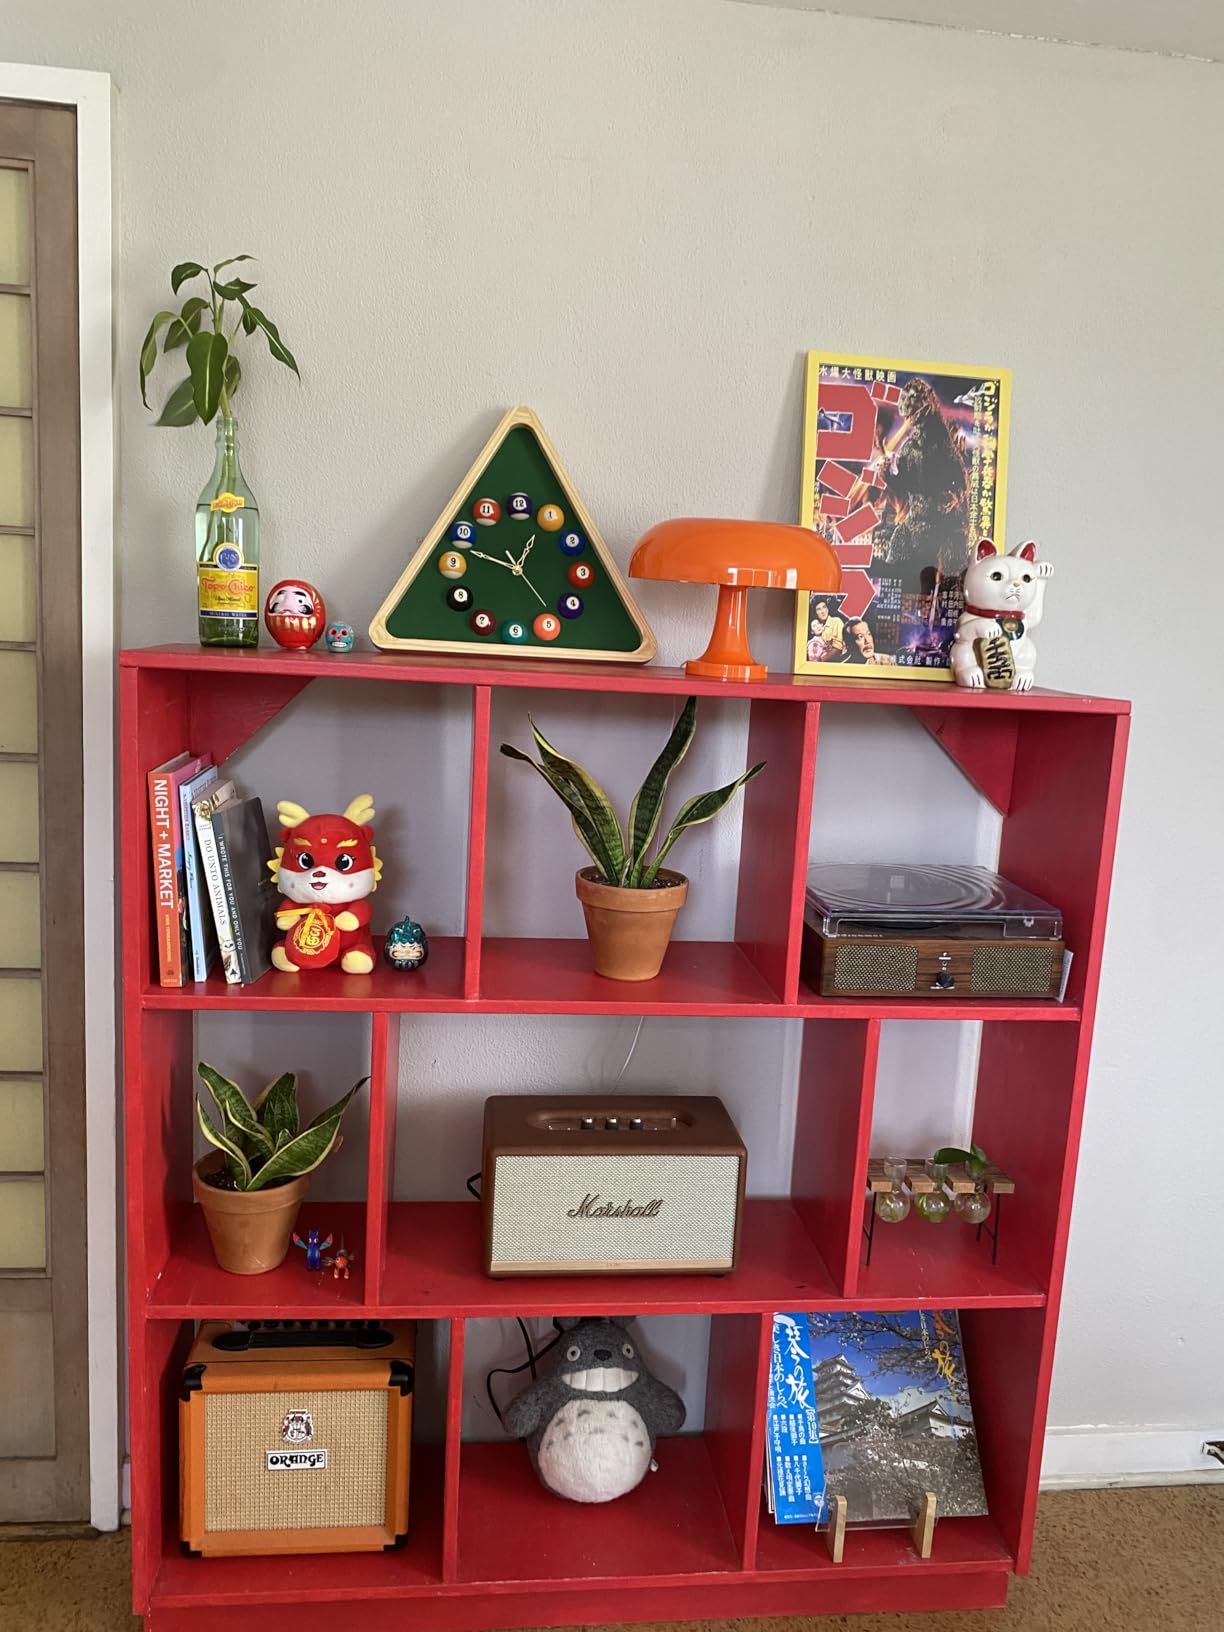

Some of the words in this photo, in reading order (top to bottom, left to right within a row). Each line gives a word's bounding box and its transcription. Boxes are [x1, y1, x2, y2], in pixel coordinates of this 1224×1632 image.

[482, 506, 491, 514] 11
[515, 499, 525, 508] 12
[202, 577, 225, 593] Topo
[226, 578, 255, 595] Chico
[154, 779, 170, 827] NIGHT
[204, 839, 212, 853] DO
[219, 841, 227, 862] WROTE
[206, 854, 217, 881] UNTO
[222, 864, 230, 877] THIS
[157, 848, 174, 909] MARKET
[213, 883, 227, 925] ANIMALS
[232, 921, 240, 937] ONLY
[567, 1193, 663, 1218] Marshall
[269, 1453, 324, 1468] ORANGE
